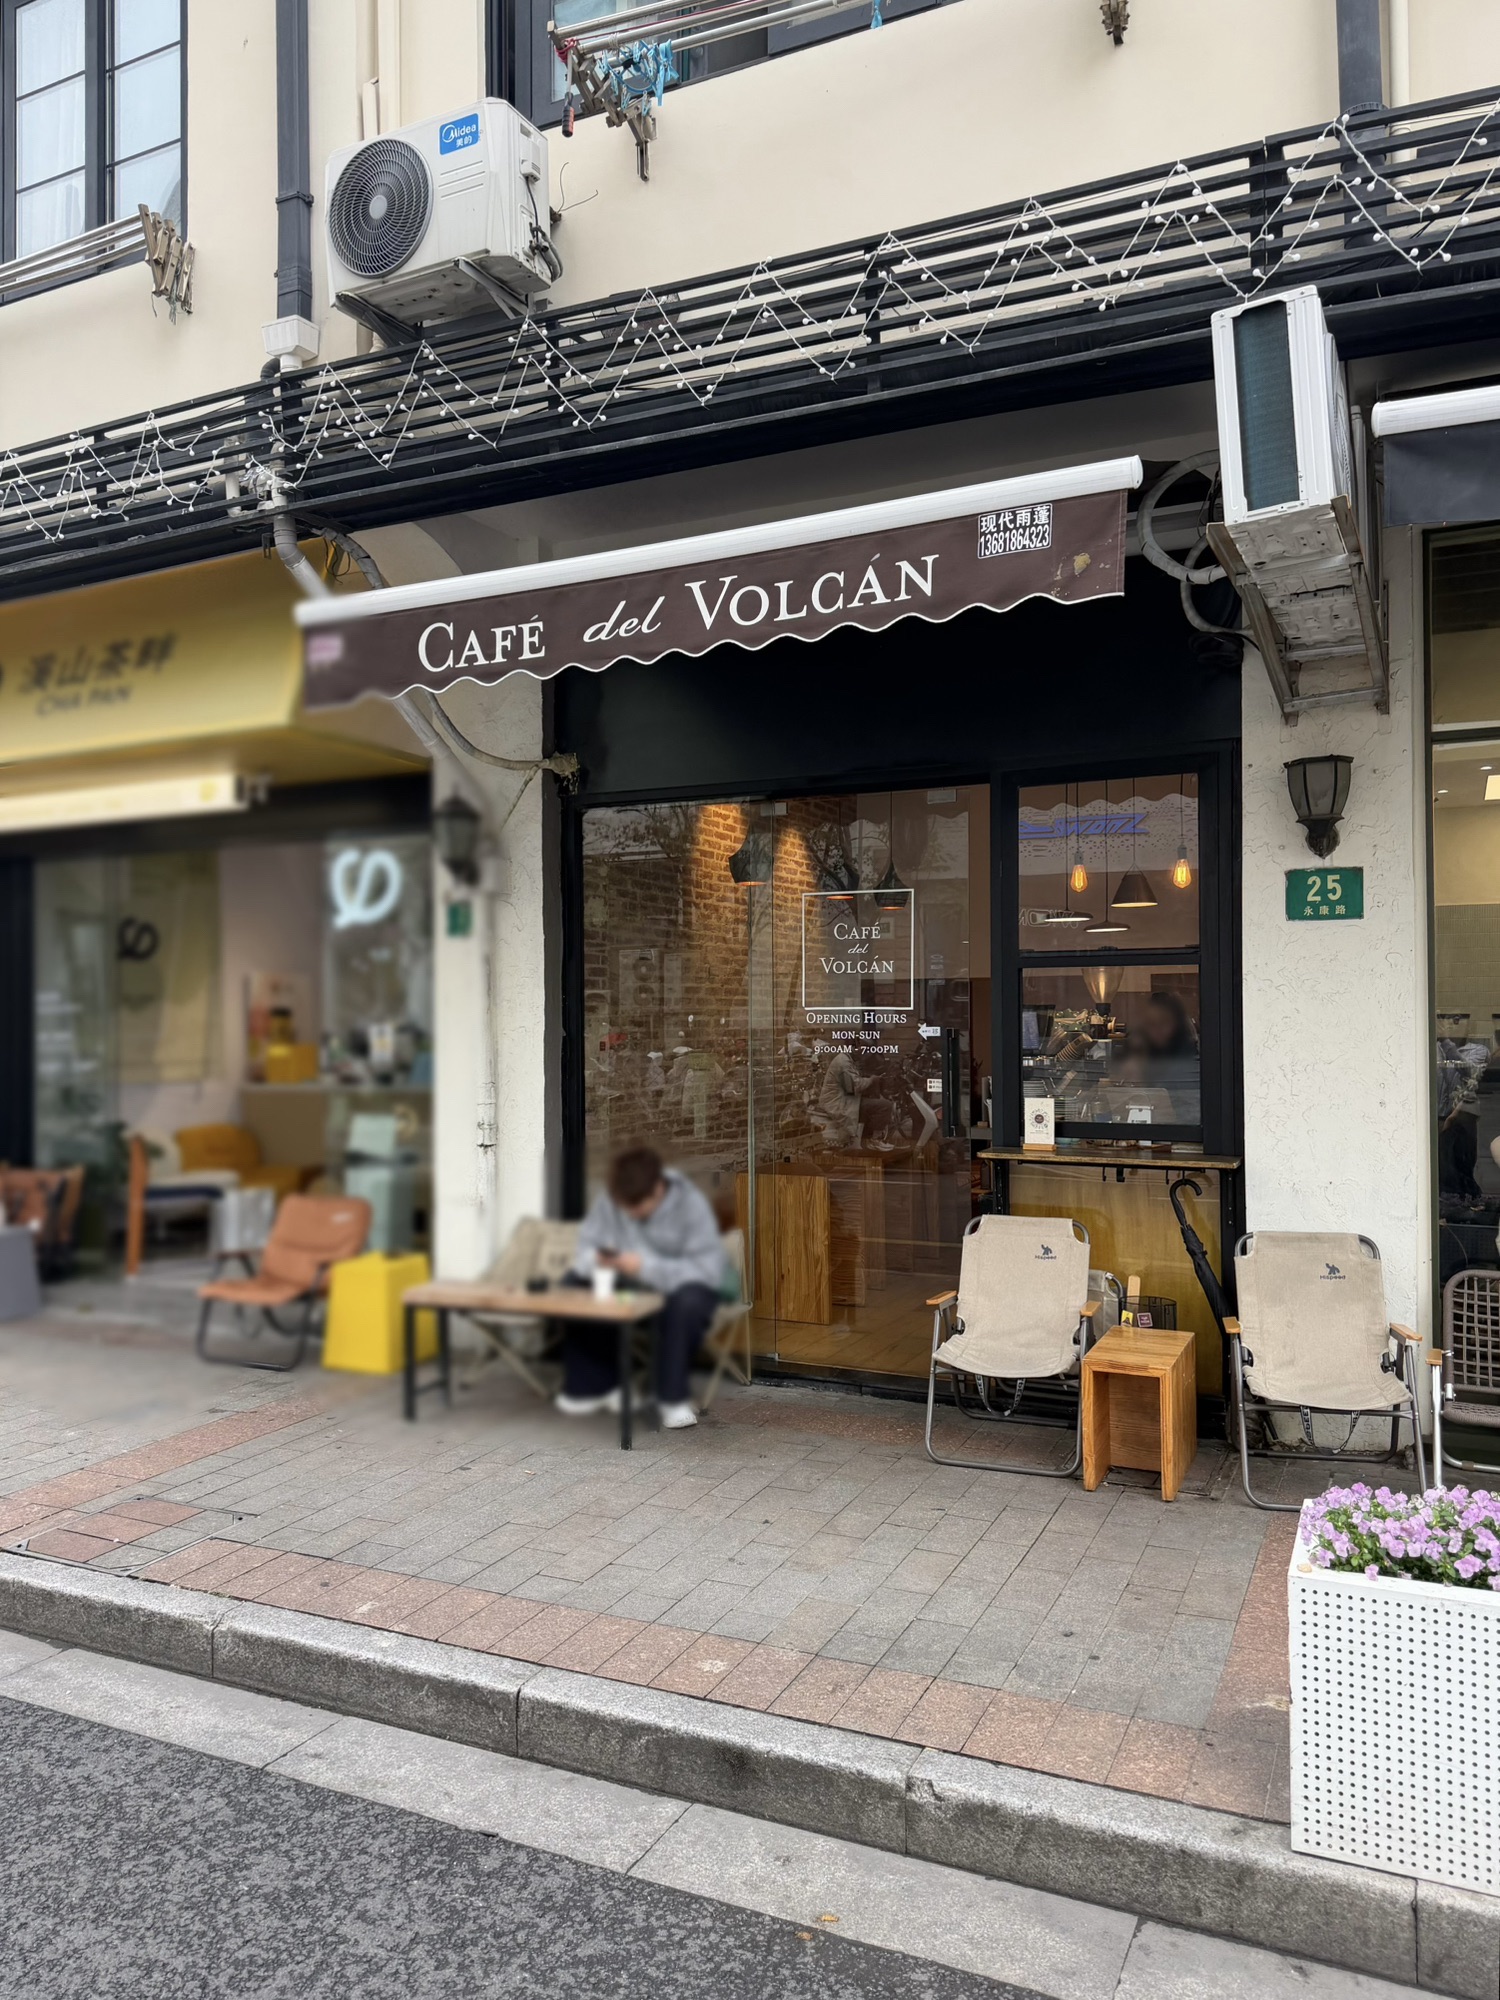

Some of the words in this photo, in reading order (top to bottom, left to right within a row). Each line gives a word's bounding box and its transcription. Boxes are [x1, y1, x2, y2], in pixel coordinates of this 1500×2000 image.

[442, 124, 477, 143] Midea
[456, 135, 473, 148] 美的
[980, 524, 1050, 556] 13681864323
[417, 614, 546, 673] CAFÉ
[582, 595, 666, 643] del
[684, 553, 940, 631] VOLCÁN
[1306, 874, 1343, 902] 25
[1303, 904, 1346, 917] 永康路
[833, 922, 881, 941] CAFÉ
[847, 943, 869, 954] del
[819, 955, 895, 974] VOLCÁN
[806, 1012, 861, 1024] OPENING
[863, 1012, 907, 1024] HOURS
[831, 1031, 881, 1040] MON-SUN
[814, 1045, 852, 1055] 9:00AM
[860, 1045, 899, 1055] 7:00PM
